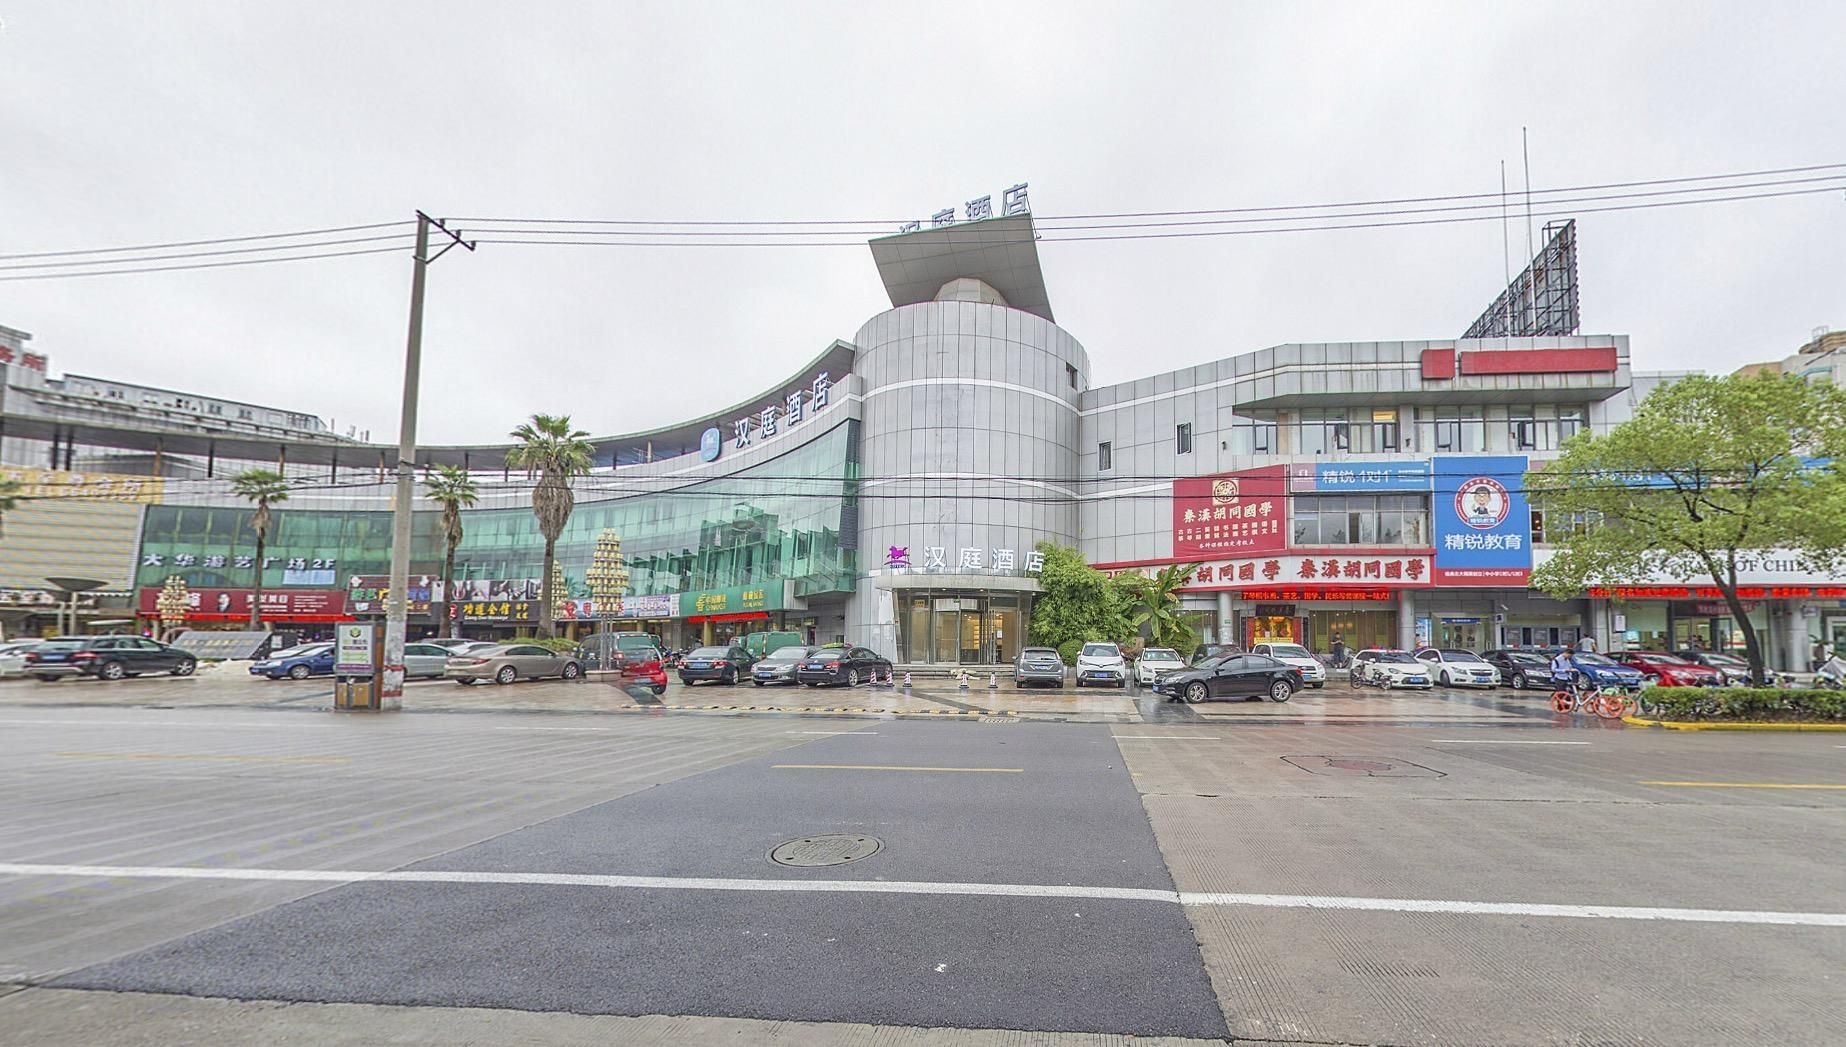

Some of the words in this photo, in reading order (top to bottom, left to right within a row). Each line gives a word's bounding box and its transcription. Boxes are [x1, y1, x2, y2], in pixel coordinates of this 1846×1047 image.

[734, 371, 829, 449] 汉庭酒店
[1183, 501, 1273, 523] 秦漢胡同國學
[1444, 533, 1523, 551] 精锐教育
[143, 553, 306, 570] 大华游艺广场
[312, 558, 337, 569] 2F
[923, 545, 1046, 573] 汉庭酒店
[1734, 560, 1759, 572] OF
[1157, 559, 1281, 586] 胡同國學
[1296, 558, 1427, 581] 秦漢胡同國學
